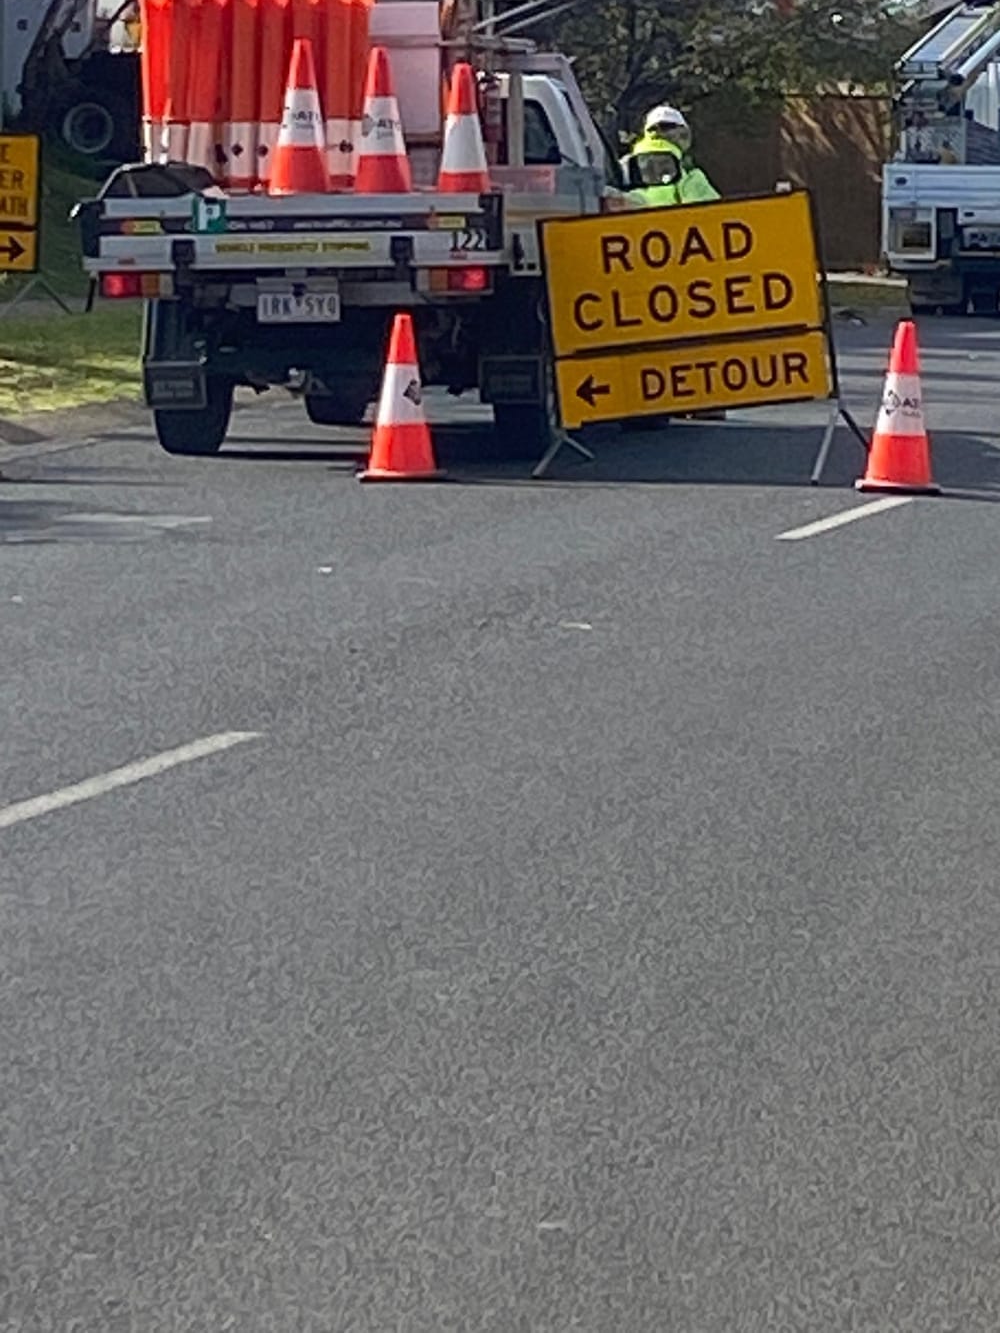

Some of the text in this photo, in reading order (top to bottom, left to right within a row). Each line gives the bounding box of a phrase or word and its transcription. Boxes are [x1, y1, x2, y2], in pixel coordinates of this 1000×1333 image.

[450, 230, 485, 252] 122
[600, 221, 754, 274] ROAD
[573, 273, 793, 332] CLOSED
[640, 351, 809, 401] DETOUR
